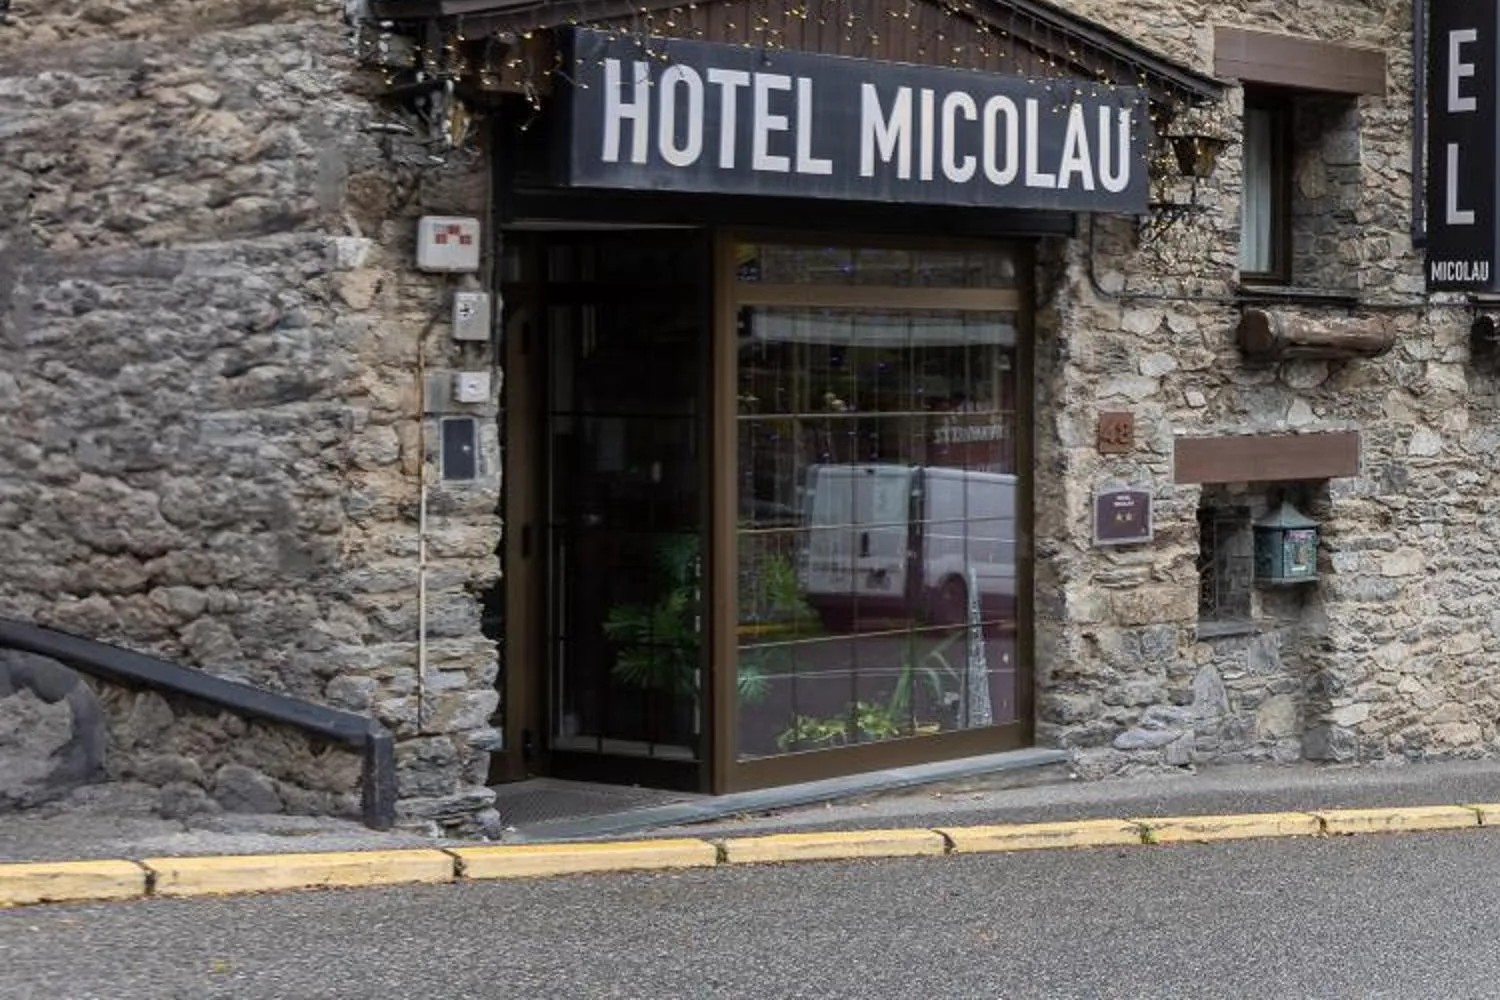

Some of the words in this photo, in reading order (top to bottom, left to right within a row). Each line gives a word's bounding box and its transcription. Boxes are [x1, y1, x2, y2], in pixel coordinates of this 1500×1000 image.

[601, 59, 834, 175] HOTEL
[859, 83, 1132, 194] MICOLAU
[1431, 260, 1489, 281] MICOLAU
